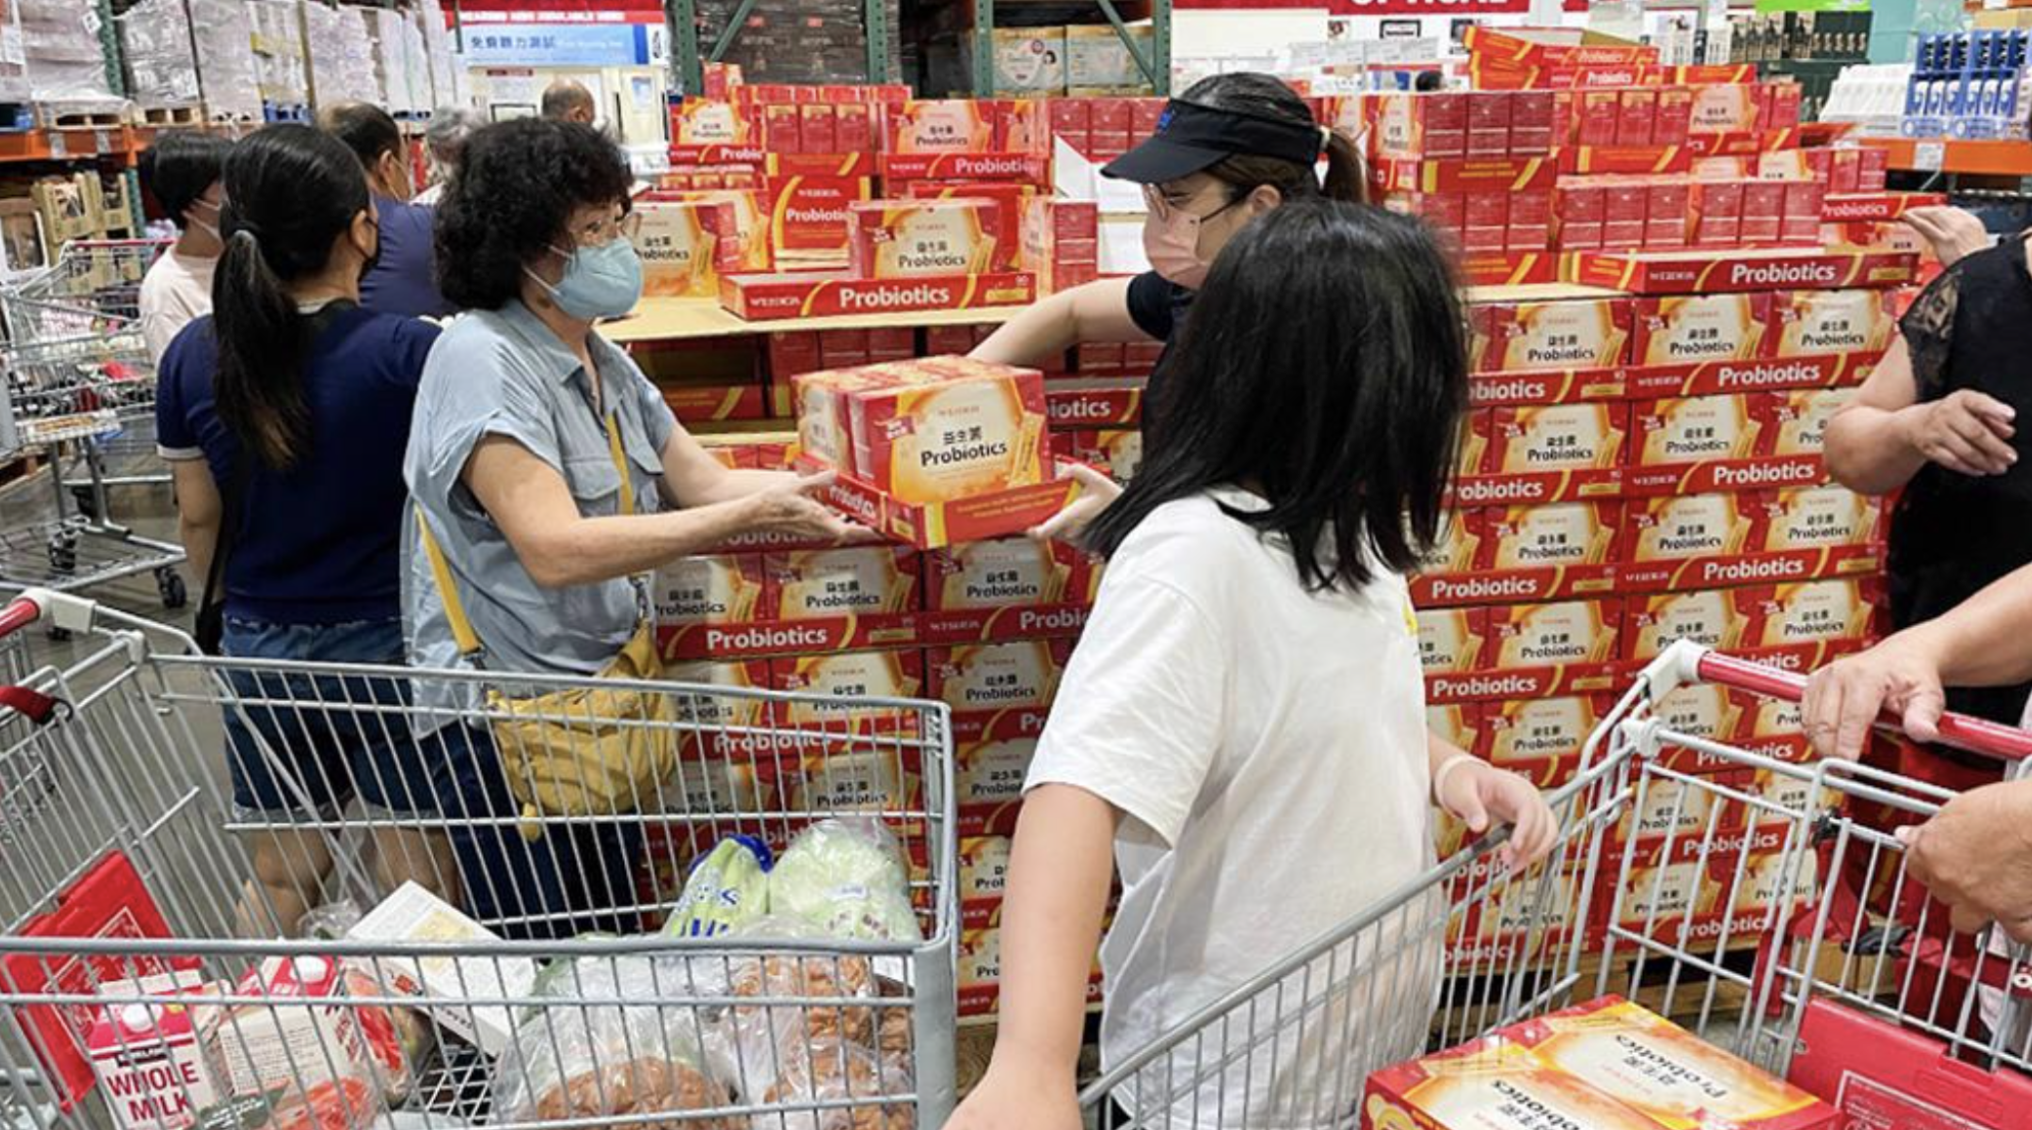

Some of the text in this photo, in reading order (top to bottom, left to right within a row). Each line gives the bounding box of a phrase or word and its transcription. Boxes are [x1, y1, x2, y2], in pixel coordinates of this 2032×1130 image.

[897, 253, 967, 268] Probiotics
[1731, 264, 1837, 284] Probiotics
[840, 286, 950, 308] Probiotics
[1669, 342, 1735, 355] Probiotics
[1801, 333, 1866, 347] Probiotics
[1528, 348, 1595, 361] Probiotics
[1718, 365, 1821, 387] Probiotics
[1047, 397, 1111, 418] iotics
[942, 426, 984, 446] 益生菌
[920, 441, 1008, 467] Probiotics
[1528, 449, 1593, 462] Probiotics
[1714, 463, 1816, 486] Probiotics
[1788, 526, 1851, 539] Probiotics
[1518, 547, 1584, 560] Probiotics
[1704, 557, 1805, 580] Probiotics
[967, 585, 1038, 598] Probiotics
[1432, 577, 1538, 598] Probiotics
[806, 593, 881, 607] Probiotics
[707, 626, 828, 650] Probiotics
[1521, 647, 1586, 659] Probiotics
[966, 687, 1036, 700] Probiotics
[1433, 675, 1538, 697] Probiotics
[1616, 1034, 1728, 1098] Probiotics
[106, 1060, 200, 1097] WHOLE
